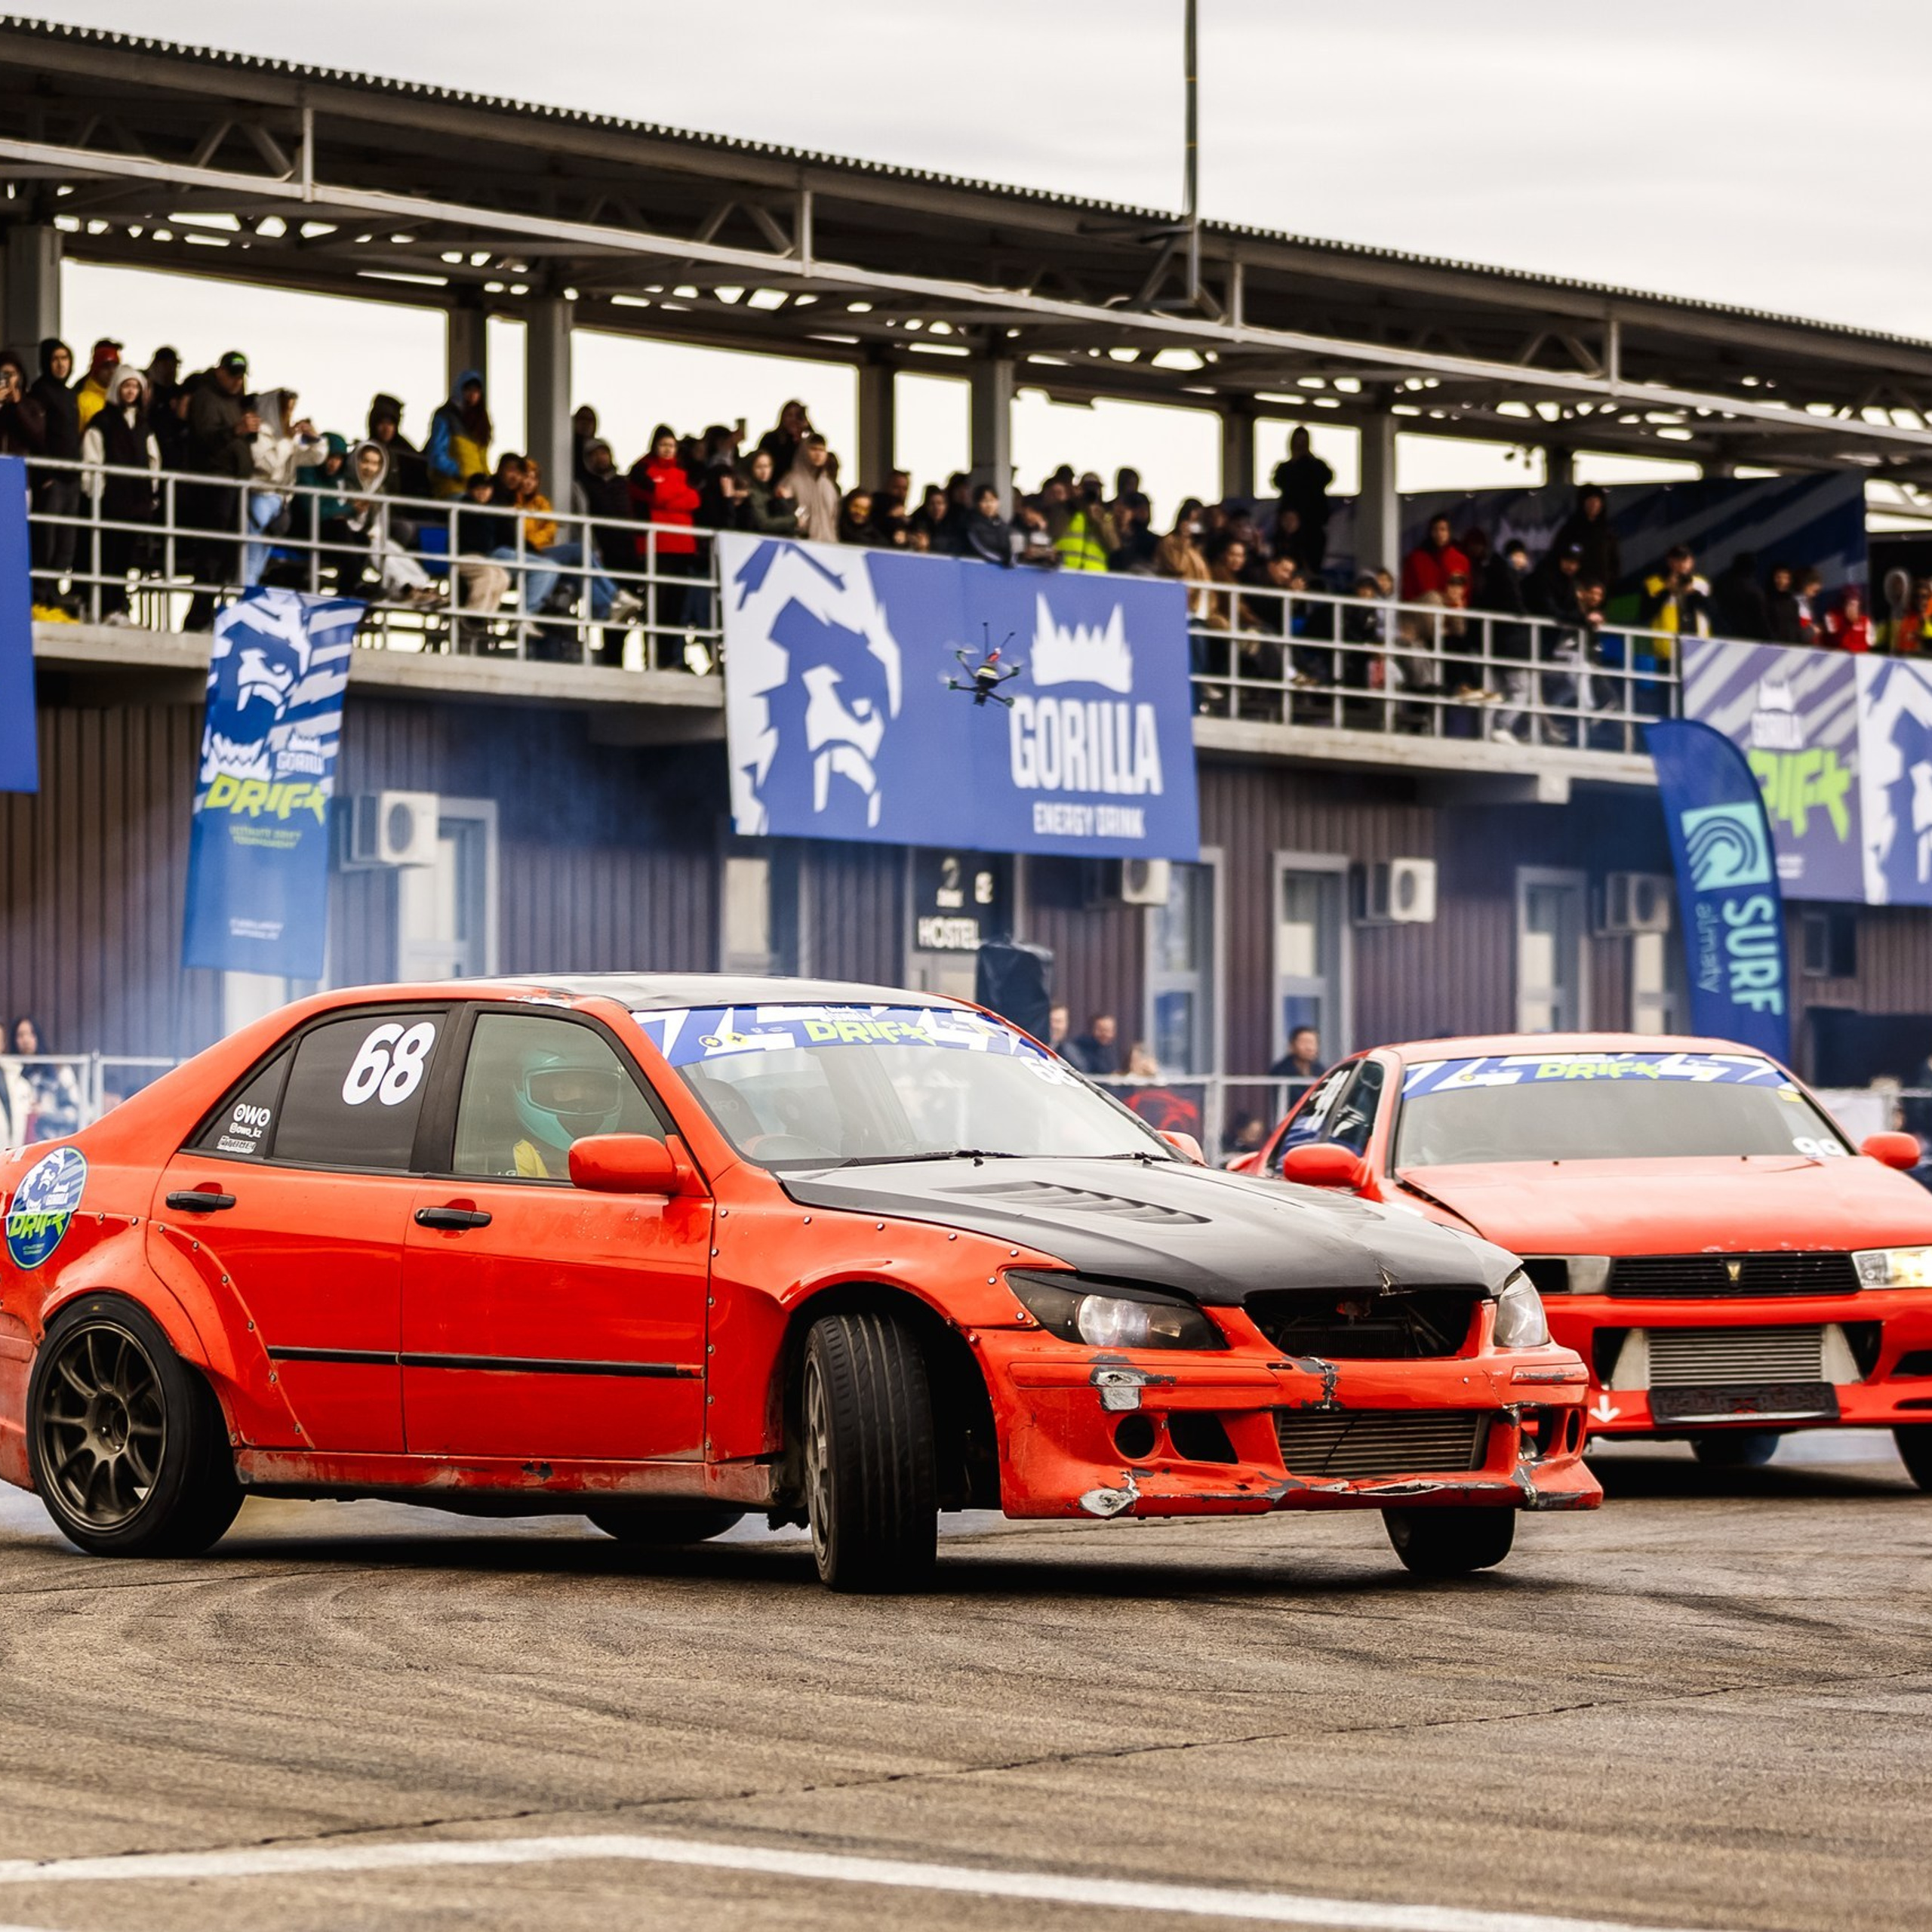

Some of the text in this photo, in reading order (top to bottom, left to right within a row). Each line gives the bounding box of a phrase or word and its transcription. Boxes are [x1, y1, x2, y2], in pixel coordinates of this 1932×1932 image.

[1009, 694, 1164, 795] GORILLA
[204, 772, 327, 827] DRIFT
[1748, 746, 1851, 844] RIFT
[1032, 801, 1146, 839] ENERGY DRINK
[918, 916, 982, 951] HOSTEL
[1721, 894, 1785, 1016] SURF
[802, 1020, 937, 1046] DRIFT
[342, 1022, 436, 1106] 68
[1019, 1056, 1083, 1088] 68
[1534, 1061, 1662, 1080] DRIFT
[233, 1103, 271, 1127] OWO
[8, 1209, 67, 1240] DRIFT
